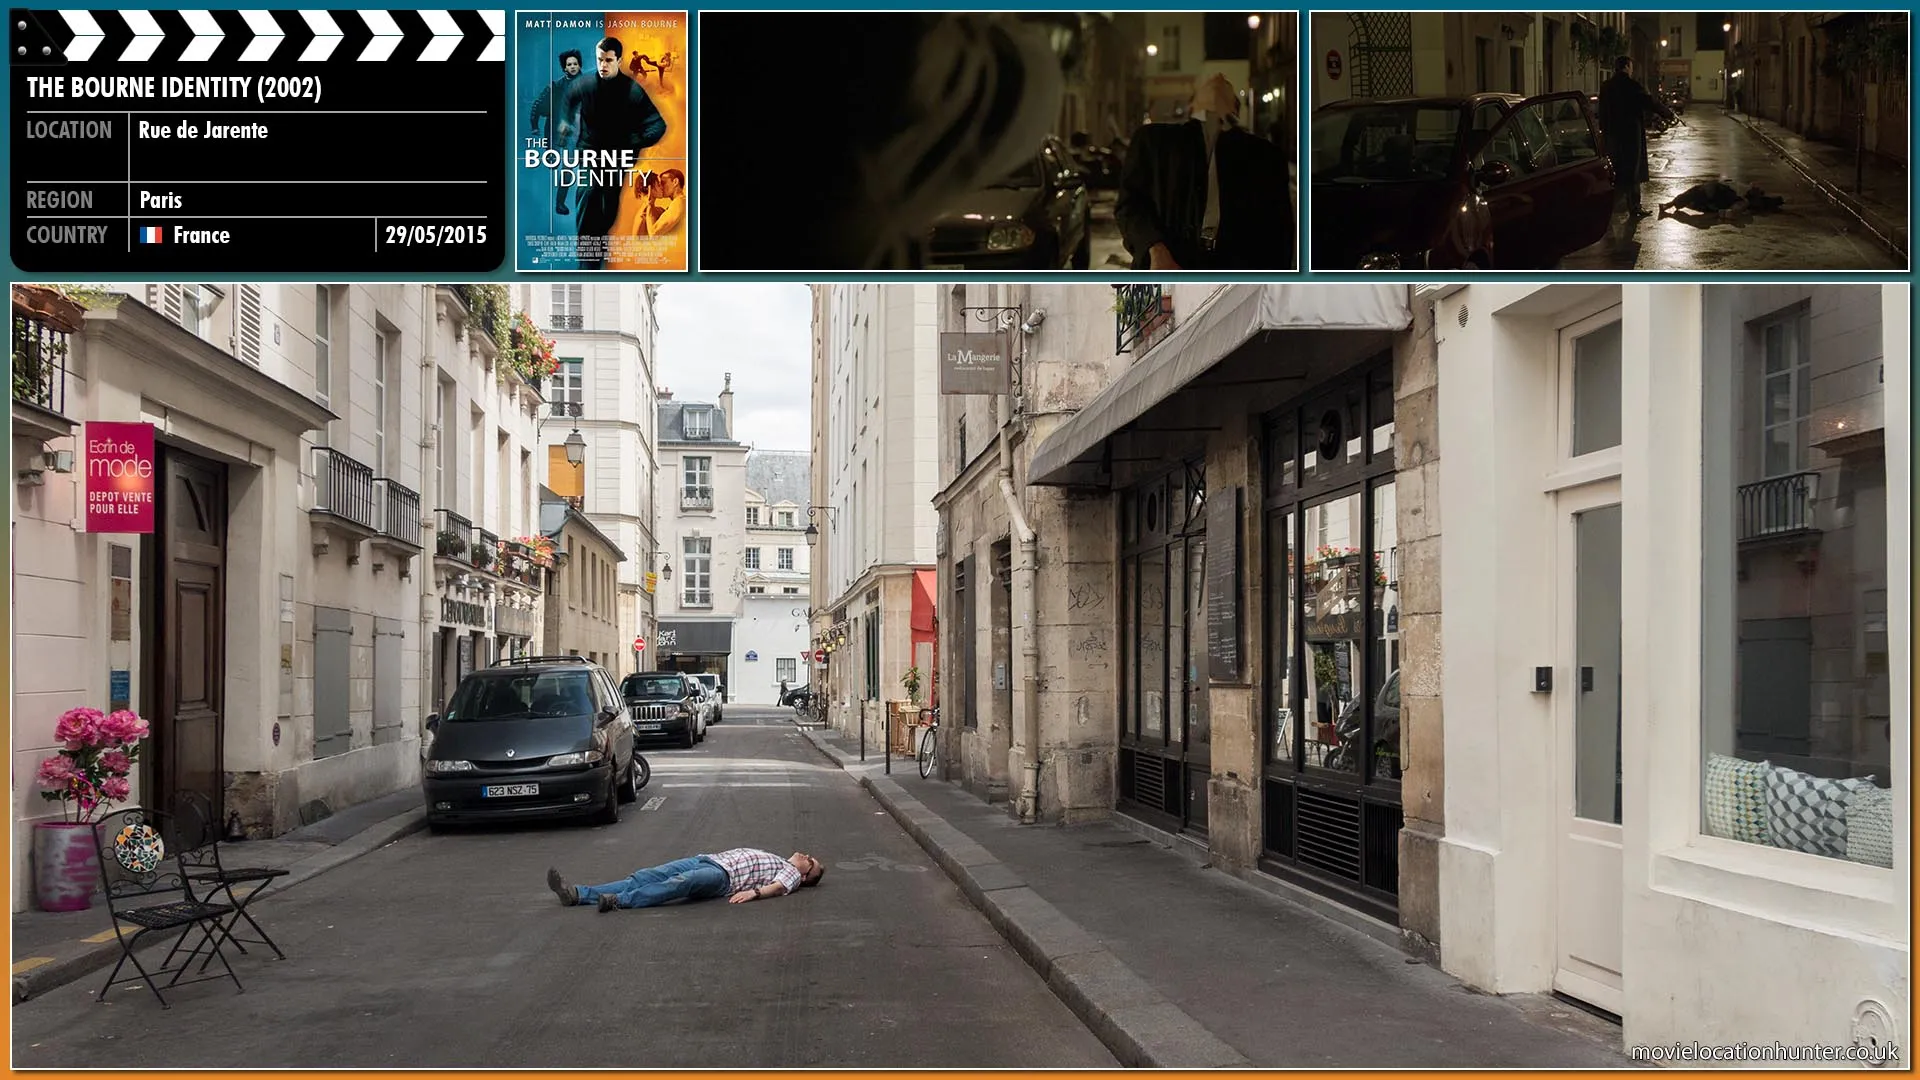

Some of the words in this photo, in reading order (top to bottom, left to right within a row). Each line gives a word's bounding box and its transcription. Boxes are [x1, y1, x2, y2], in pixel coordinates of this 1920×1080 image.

[525, 20, 551, 28] MATT
[555, 20, 592, 28] DAMON
[595, 20, 604, 28] IS
[607, 20, 637, 28] JASON
[640, 20, 678, 28] BOURNE
[525, 137, 548, 148] THE
[524, 149, 634, 168] BOURNE
[554, 169, 652, 187] IDENTITY
[957, 350, 1001, 363] Mangerie
[89, 437, 118, 454] Ecrin
[119, 441, 135, 454] de
[89, 454, 152, 478] mode
[89, 491, 120, 502] DEPOT
[122, 492, 152, 503] VENTE
[89, 503, 115, 514] POUR
[117, 504, 139, 514] ELLE
